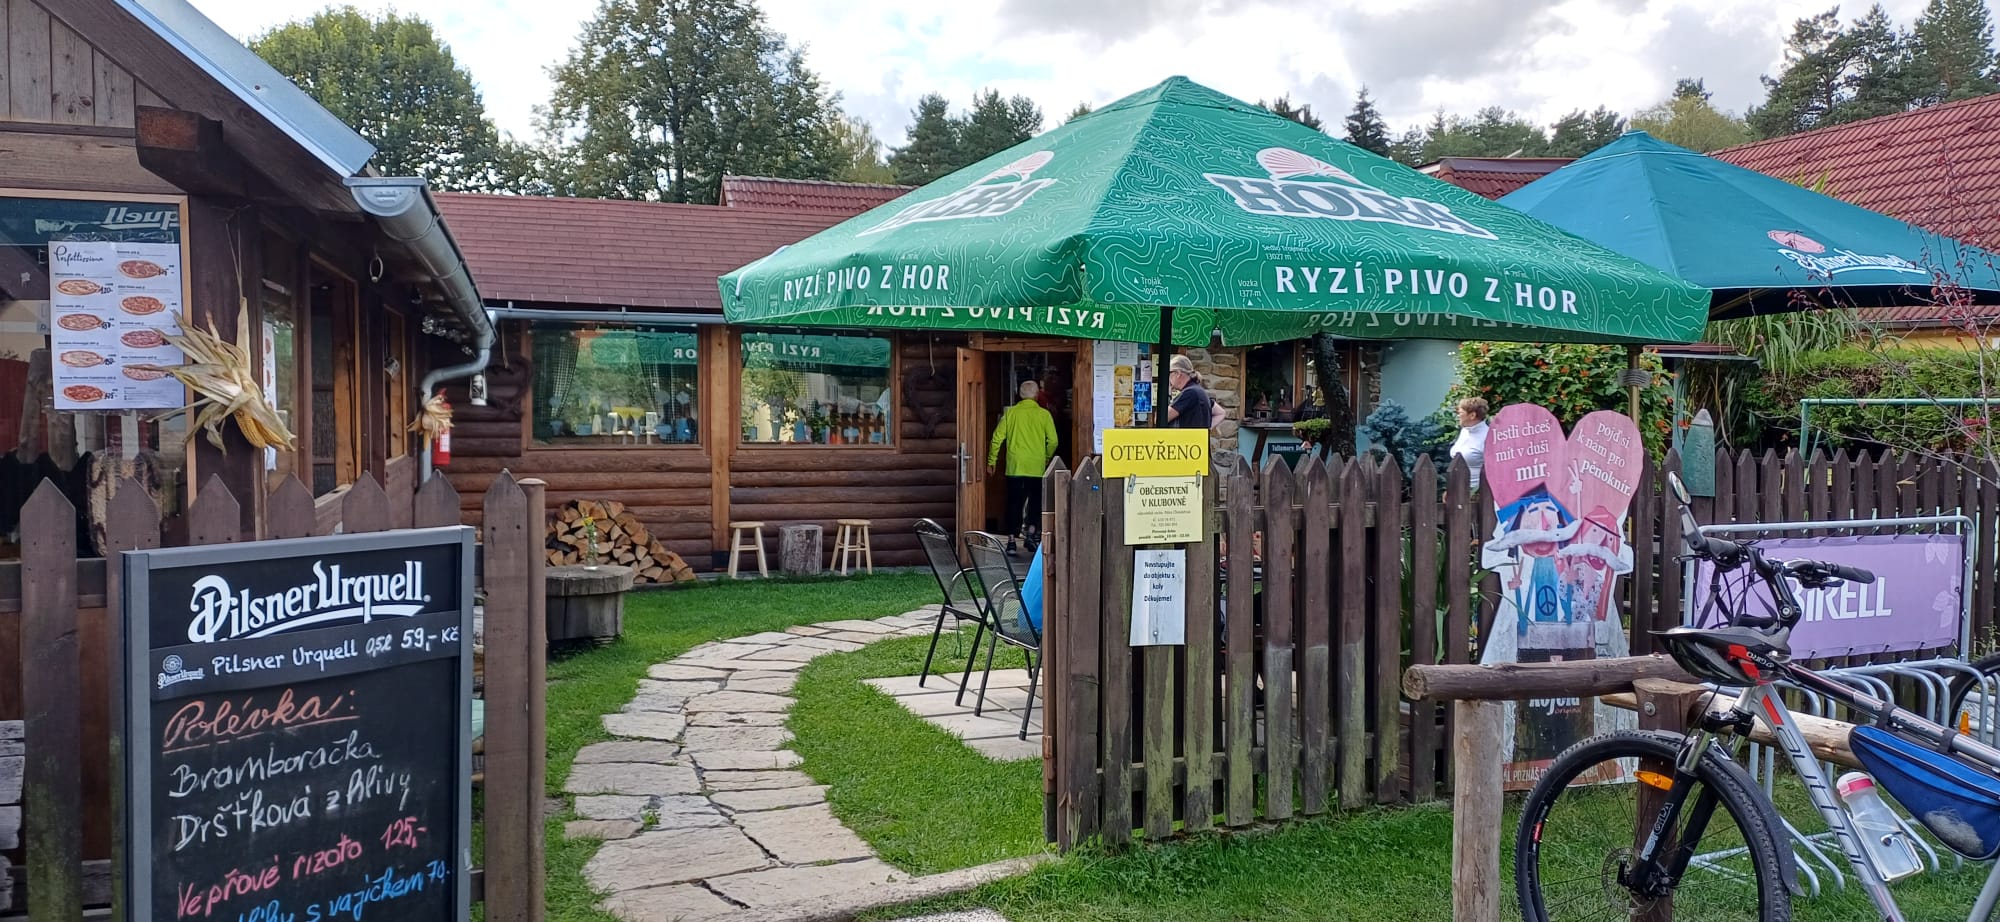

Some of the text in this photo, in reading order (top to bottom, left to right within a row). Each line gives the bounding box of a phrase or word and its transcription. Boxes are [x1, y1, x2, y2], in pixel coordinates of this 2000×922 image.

[1207, 176, 1493, 238] HOLBA
[784, 268, 821, 301] RYZÍ
[827, 266, 871, 294] PIVO
[880, 265, 893, 289] Z
[902, 265, 949, 290] HOR
[1275, 261, 1578, 315] RYZÍ PIVO Z HOR
[1493, 419, 1551, 444] Jestli chceš
[1597, 423, 1631, 448] pojď si
[1110, 440, 1202, 461] OTEVŘENO
[1496, 440, 1549, 462] mít v duši
[1576, 429, 1625, 468] k nám pro
[1516, 458, 1550, 481] mír,
[1140, 485, 1188, 495] OBČERSTVENÍ
[1142, 496, 1186, 507] V KLUBOVNĚ
[1151, 571, 1170, 579] objektu
[212, 655, 285, 675] Pilsner
[292, 640, 357, 671] Urquell
[441, 626, 459, 643] Kč
[177, 855, 280, 920] Vepřové
[293, 833, 362, 880] rizoto
